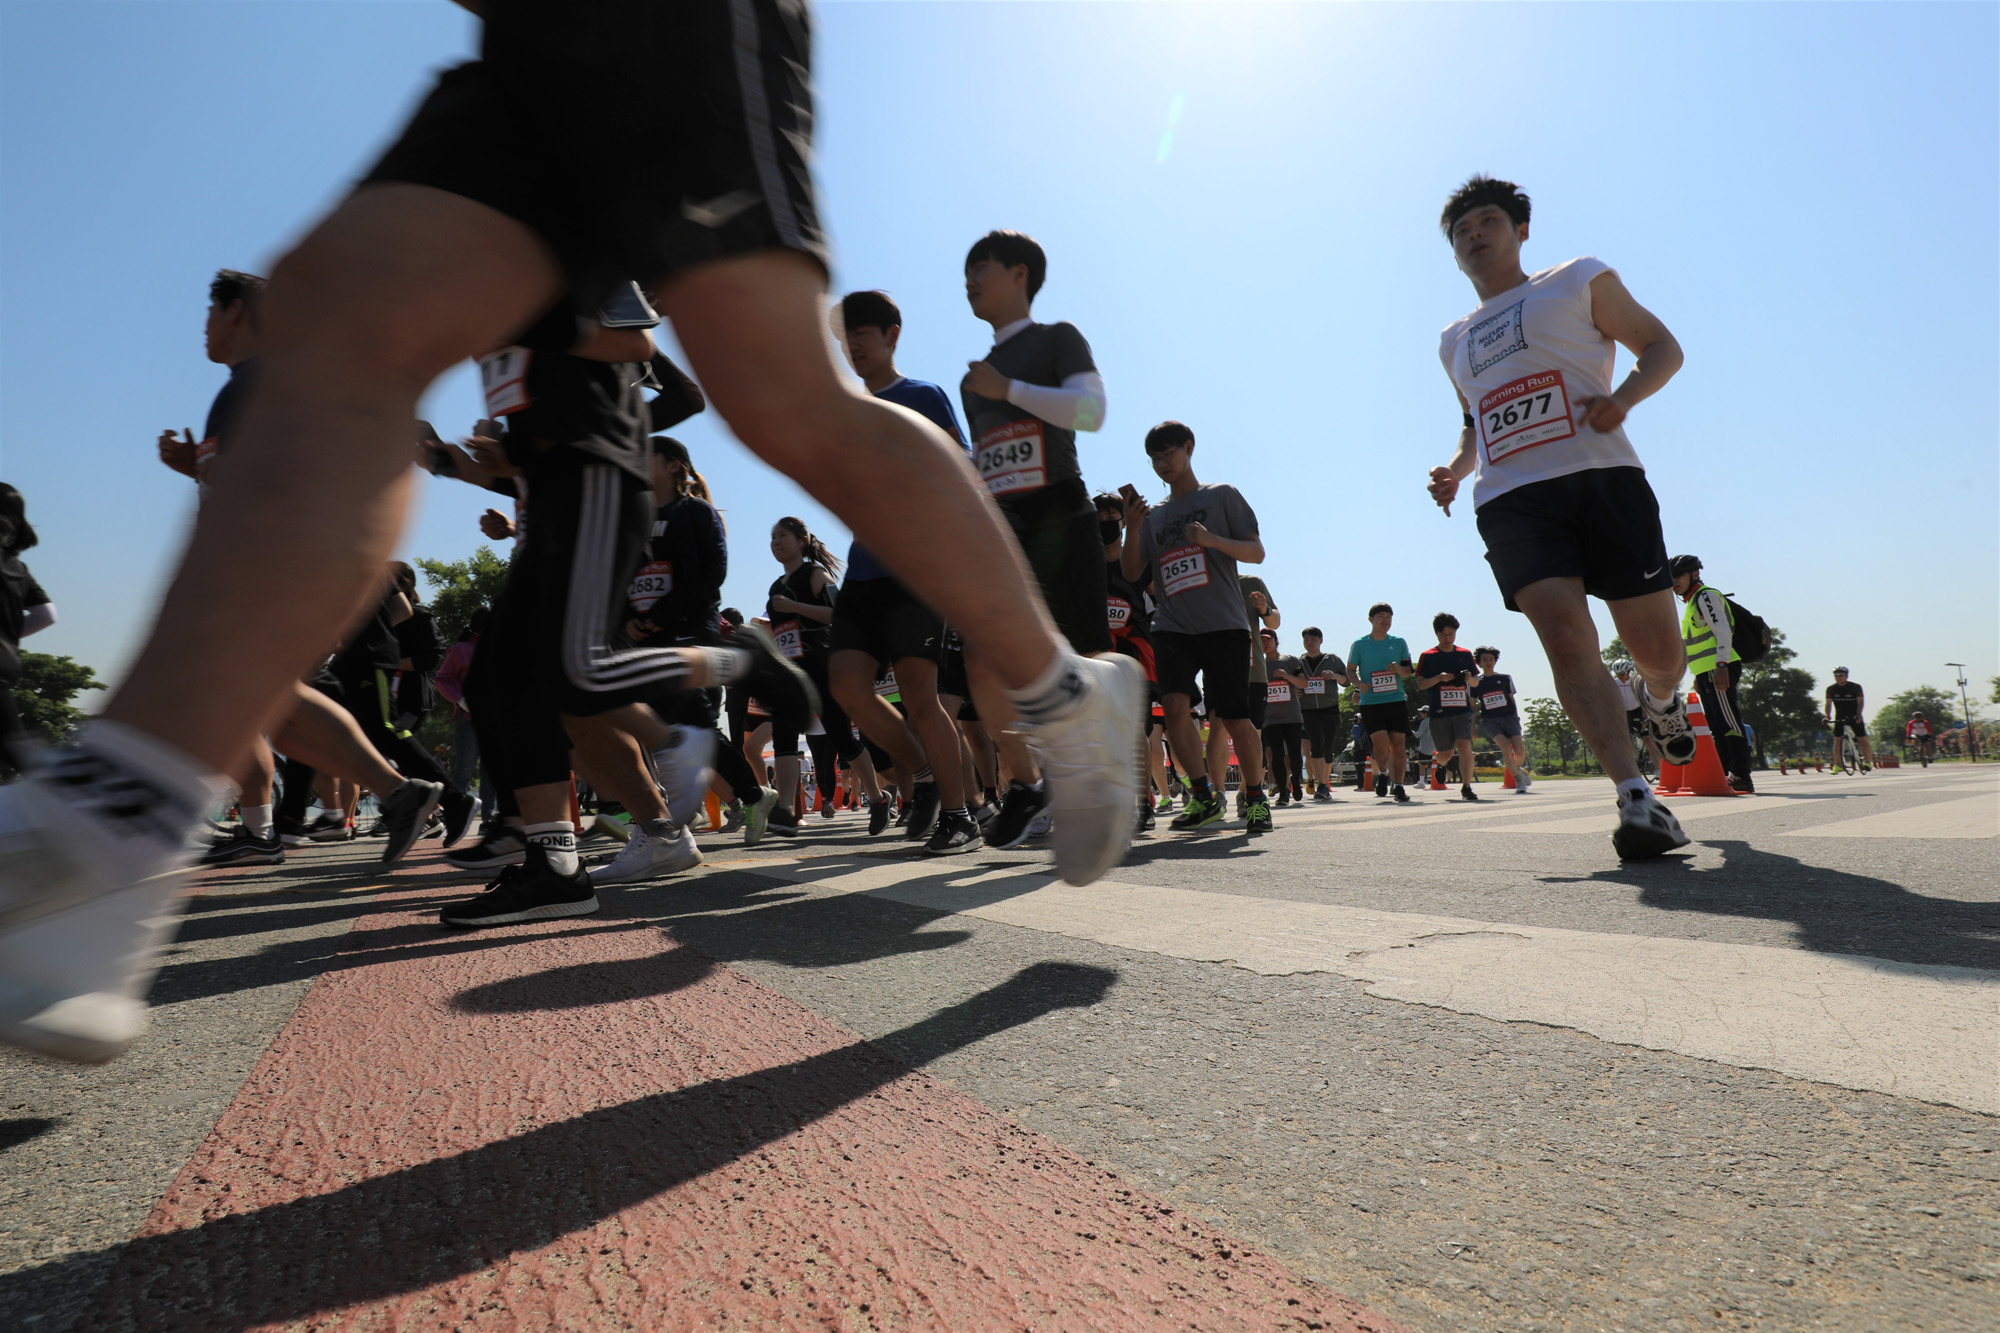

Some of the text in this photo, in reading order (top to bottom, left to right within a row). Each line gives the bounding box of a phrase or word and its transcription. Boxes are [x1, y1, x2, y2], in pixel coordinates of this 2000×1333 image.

[1478, 320, 1510, 345] MIZUNO
[1483, 330, 1505, 349] RELAY
[1482, 375, 1555, 409] Burning Run
[1489, 392, 1552, 434] 2677
[982, 441, 1033, 472] 2649
[1164, 557, 1198, 580] 2651
[630, 577, 665, 595] 2682
[1109, 608, 1125, 619] 80
[1374, 676, 1394, 685] 2757
[1267, 686, 1288, 695] 2612
[1443, 691, 1463, 699] 2511
